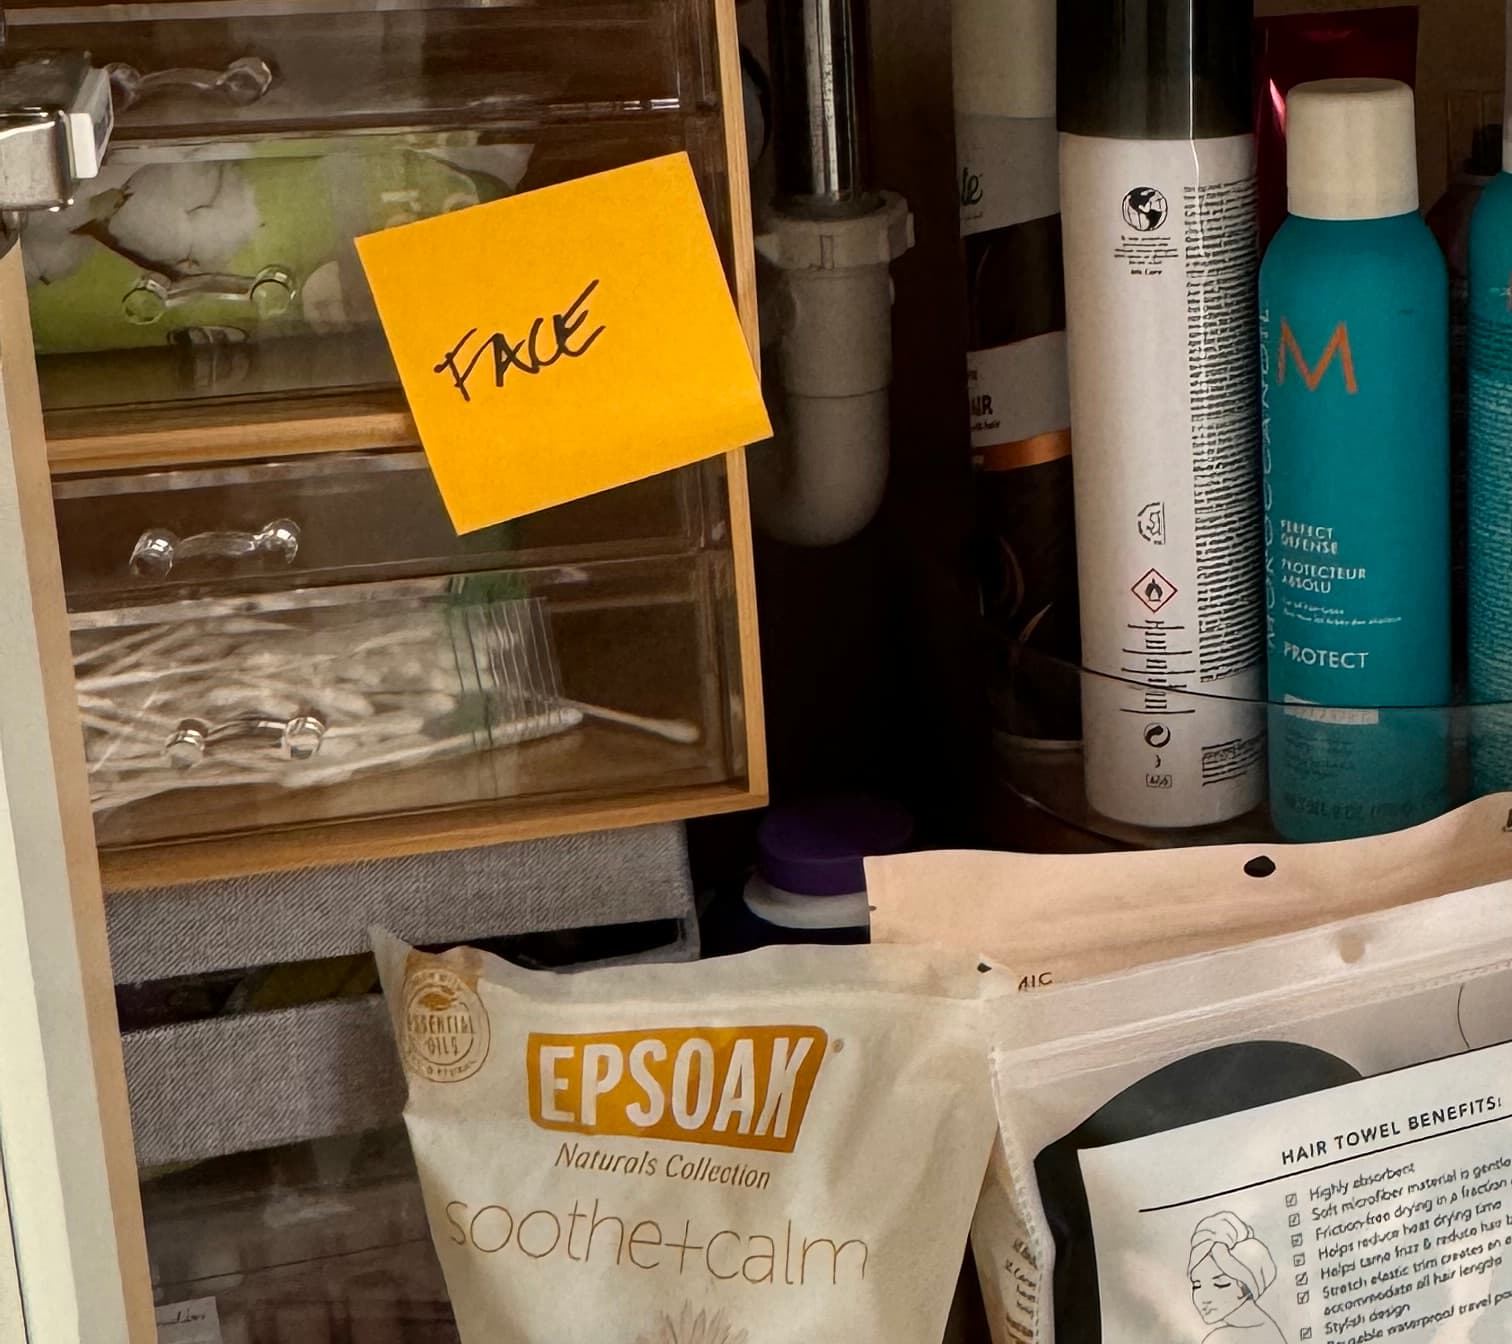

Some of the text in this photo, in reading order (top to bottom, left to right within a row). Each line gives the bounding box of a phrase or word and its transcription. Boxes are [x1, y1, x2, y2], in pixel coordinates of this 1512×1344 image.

[432, 278, 607, 403] FACE
[1277, 316, 1358, 394] M
[1282, 641, 1370, 669] PROTECT
[539, 1037, 815, 1141] EPSOAK
[1281, 1095, 1503, 1166] HAIR TOWEL BENEFITS:
[554, 1141, 773, 1191] Naturals Collection
[1308, 1176, 1350, 1203] Highly
[1311, 1204, 1338, 1223] Soft
[1407, 1169, 1458, 1195] material
[1394, 1197, 1434, 1219] drying
[1318, 1240, 1355, 1262] Helps
[1433, 1208, 1473, 1230] drying
[1457, 1293, 1493, 1316] travel
